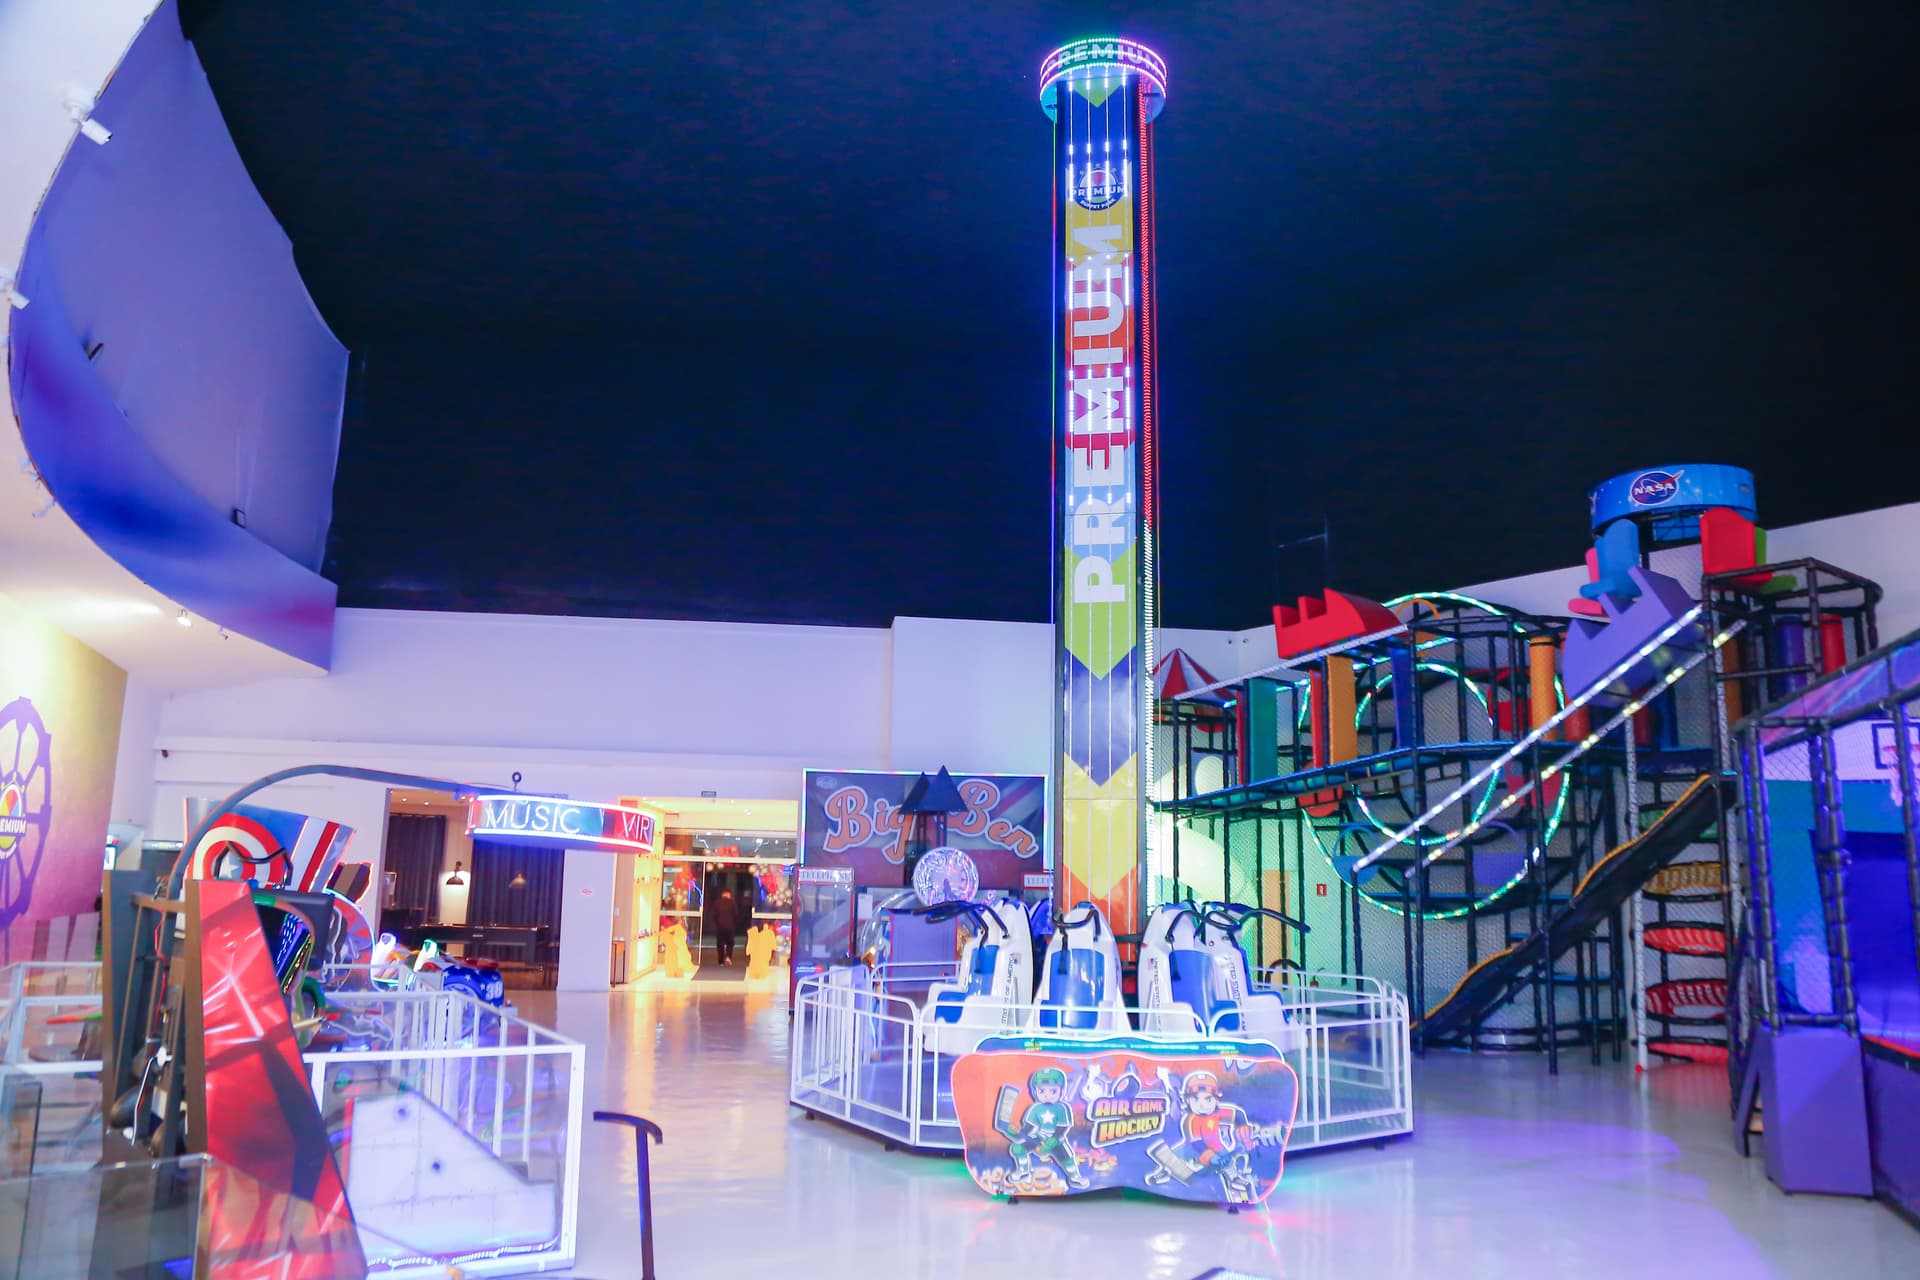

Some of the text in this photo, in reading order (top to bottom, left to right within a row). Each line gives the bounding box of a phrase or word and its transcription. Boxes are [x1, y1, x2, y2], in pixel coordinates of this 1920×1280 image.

[1047, 43, 1159, 77] PREMIUM
[1071, 186, 1127, 196] PRMUM
[1073, 224, 1127, 604] PREMIUM
[1634, 483, 1675, 496] NASA
[485, 802, 581, 834] MUSIC
[822, 778, 1039, 864] Big Ben
[799, 871, 850, 880] TELEPHNE
[1095, 1099, 1165, 1117] AIR GAME
[1098, 1115, 1160, 1142] HOCKEY
